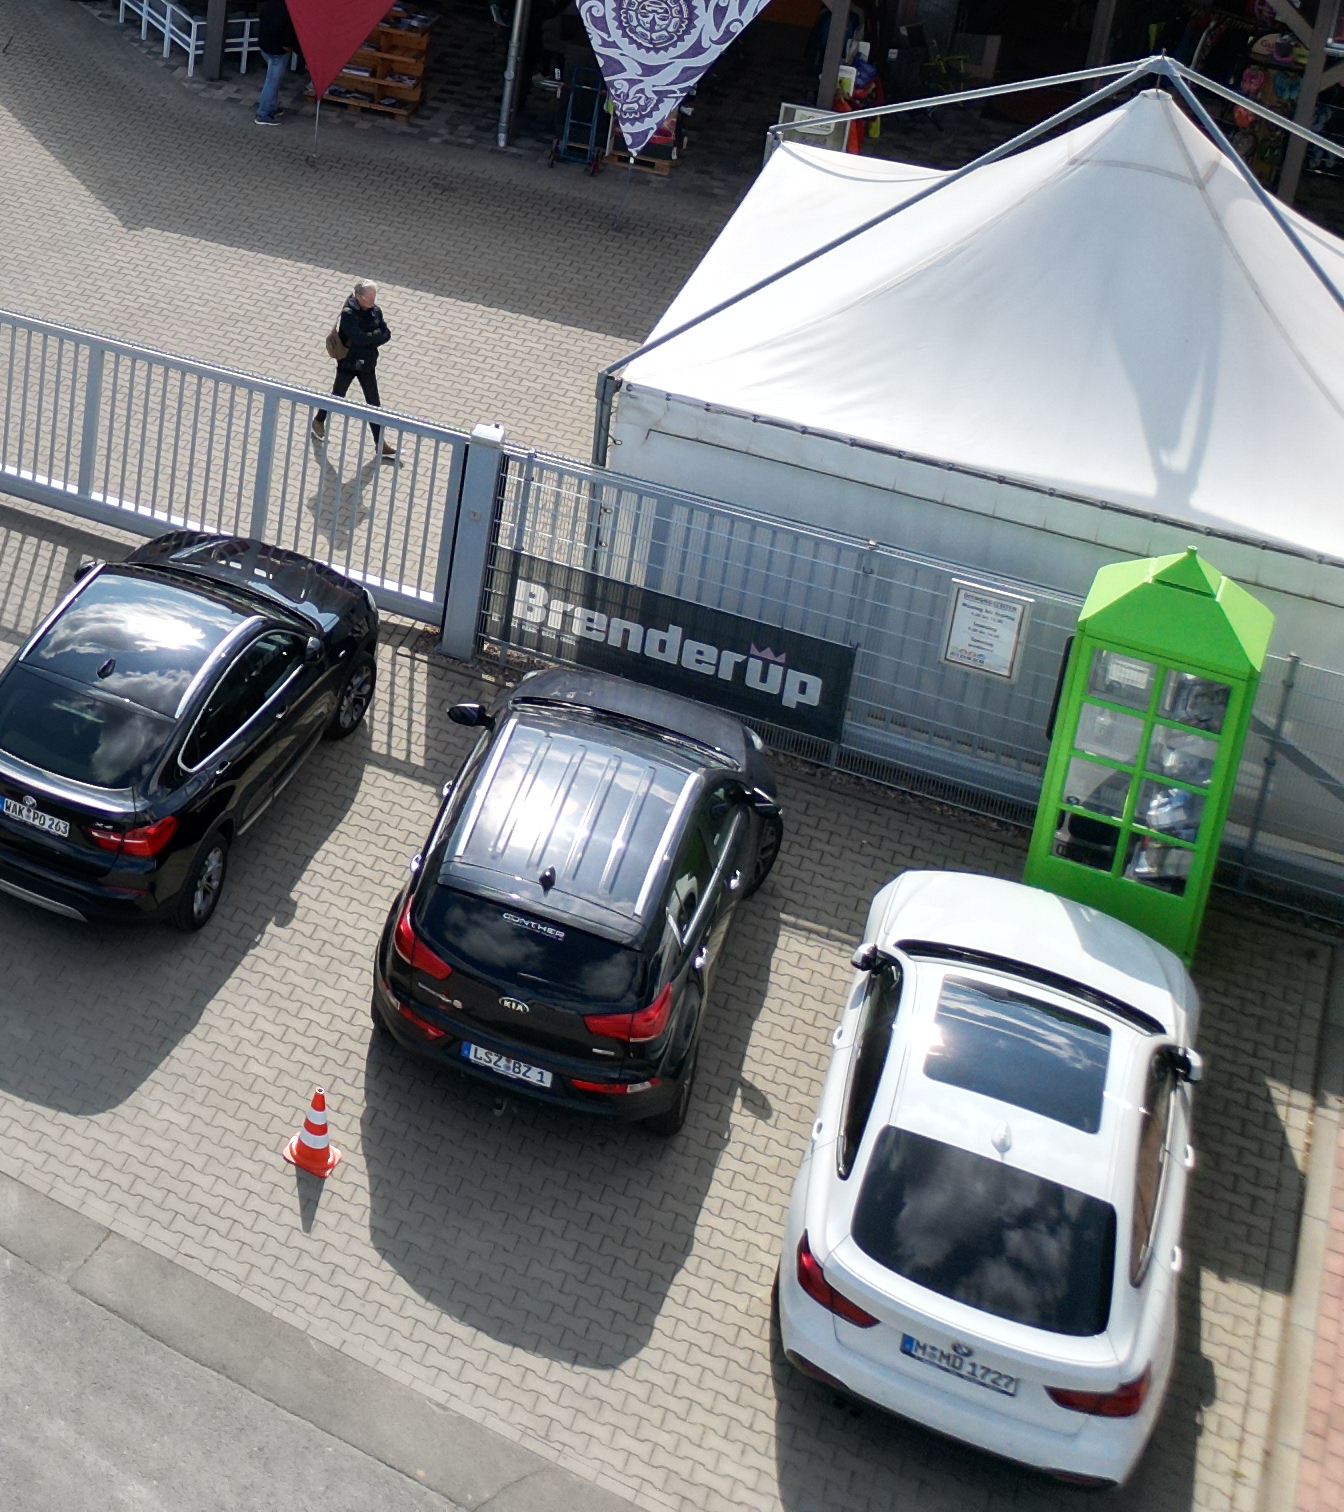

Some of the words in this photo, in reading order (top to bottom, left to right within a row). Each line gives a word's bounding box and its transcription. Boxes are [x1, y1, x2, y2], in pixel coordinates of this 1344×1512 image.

[513, 578, 823, 709] Brenderup
[5, 799, 25, 818] WAK
[48, 817, 69, 835] 263
[503, 998, 525, 1013] KIA
[474, 1047, 503, 1068] LSZ
[512, 1061, 533, 1079] BZ
[536, 1070, 545, 1084] 1
[914, 1339, 927, 1356] M
[967, 1361, 1015, 1389] 1727
